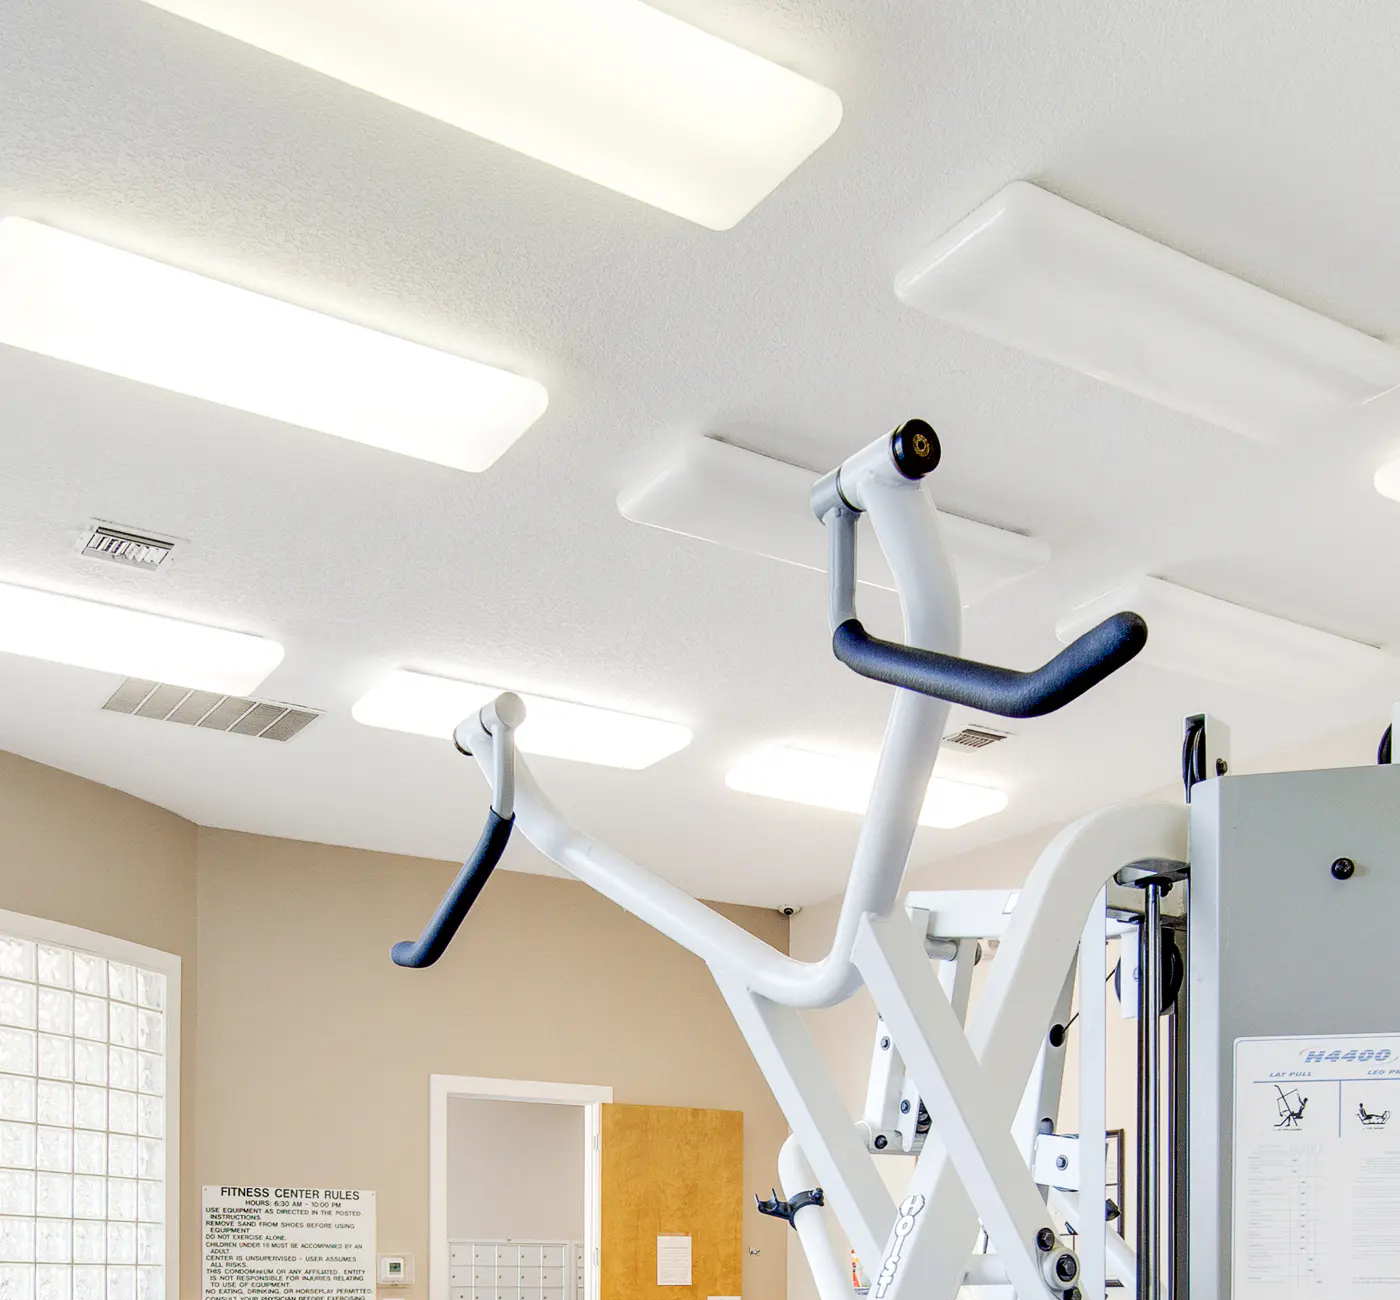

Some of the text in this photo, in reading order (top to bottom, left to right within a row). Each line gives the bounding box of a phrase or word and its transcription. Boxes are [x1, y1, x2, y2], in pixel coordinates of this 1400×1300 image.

[1305, 1049, 1391, 1063] H4400
[221, 1187, 360, 1200] FITNESS CENTER RULES
[876, 1194, 925, 1298] HOIST
